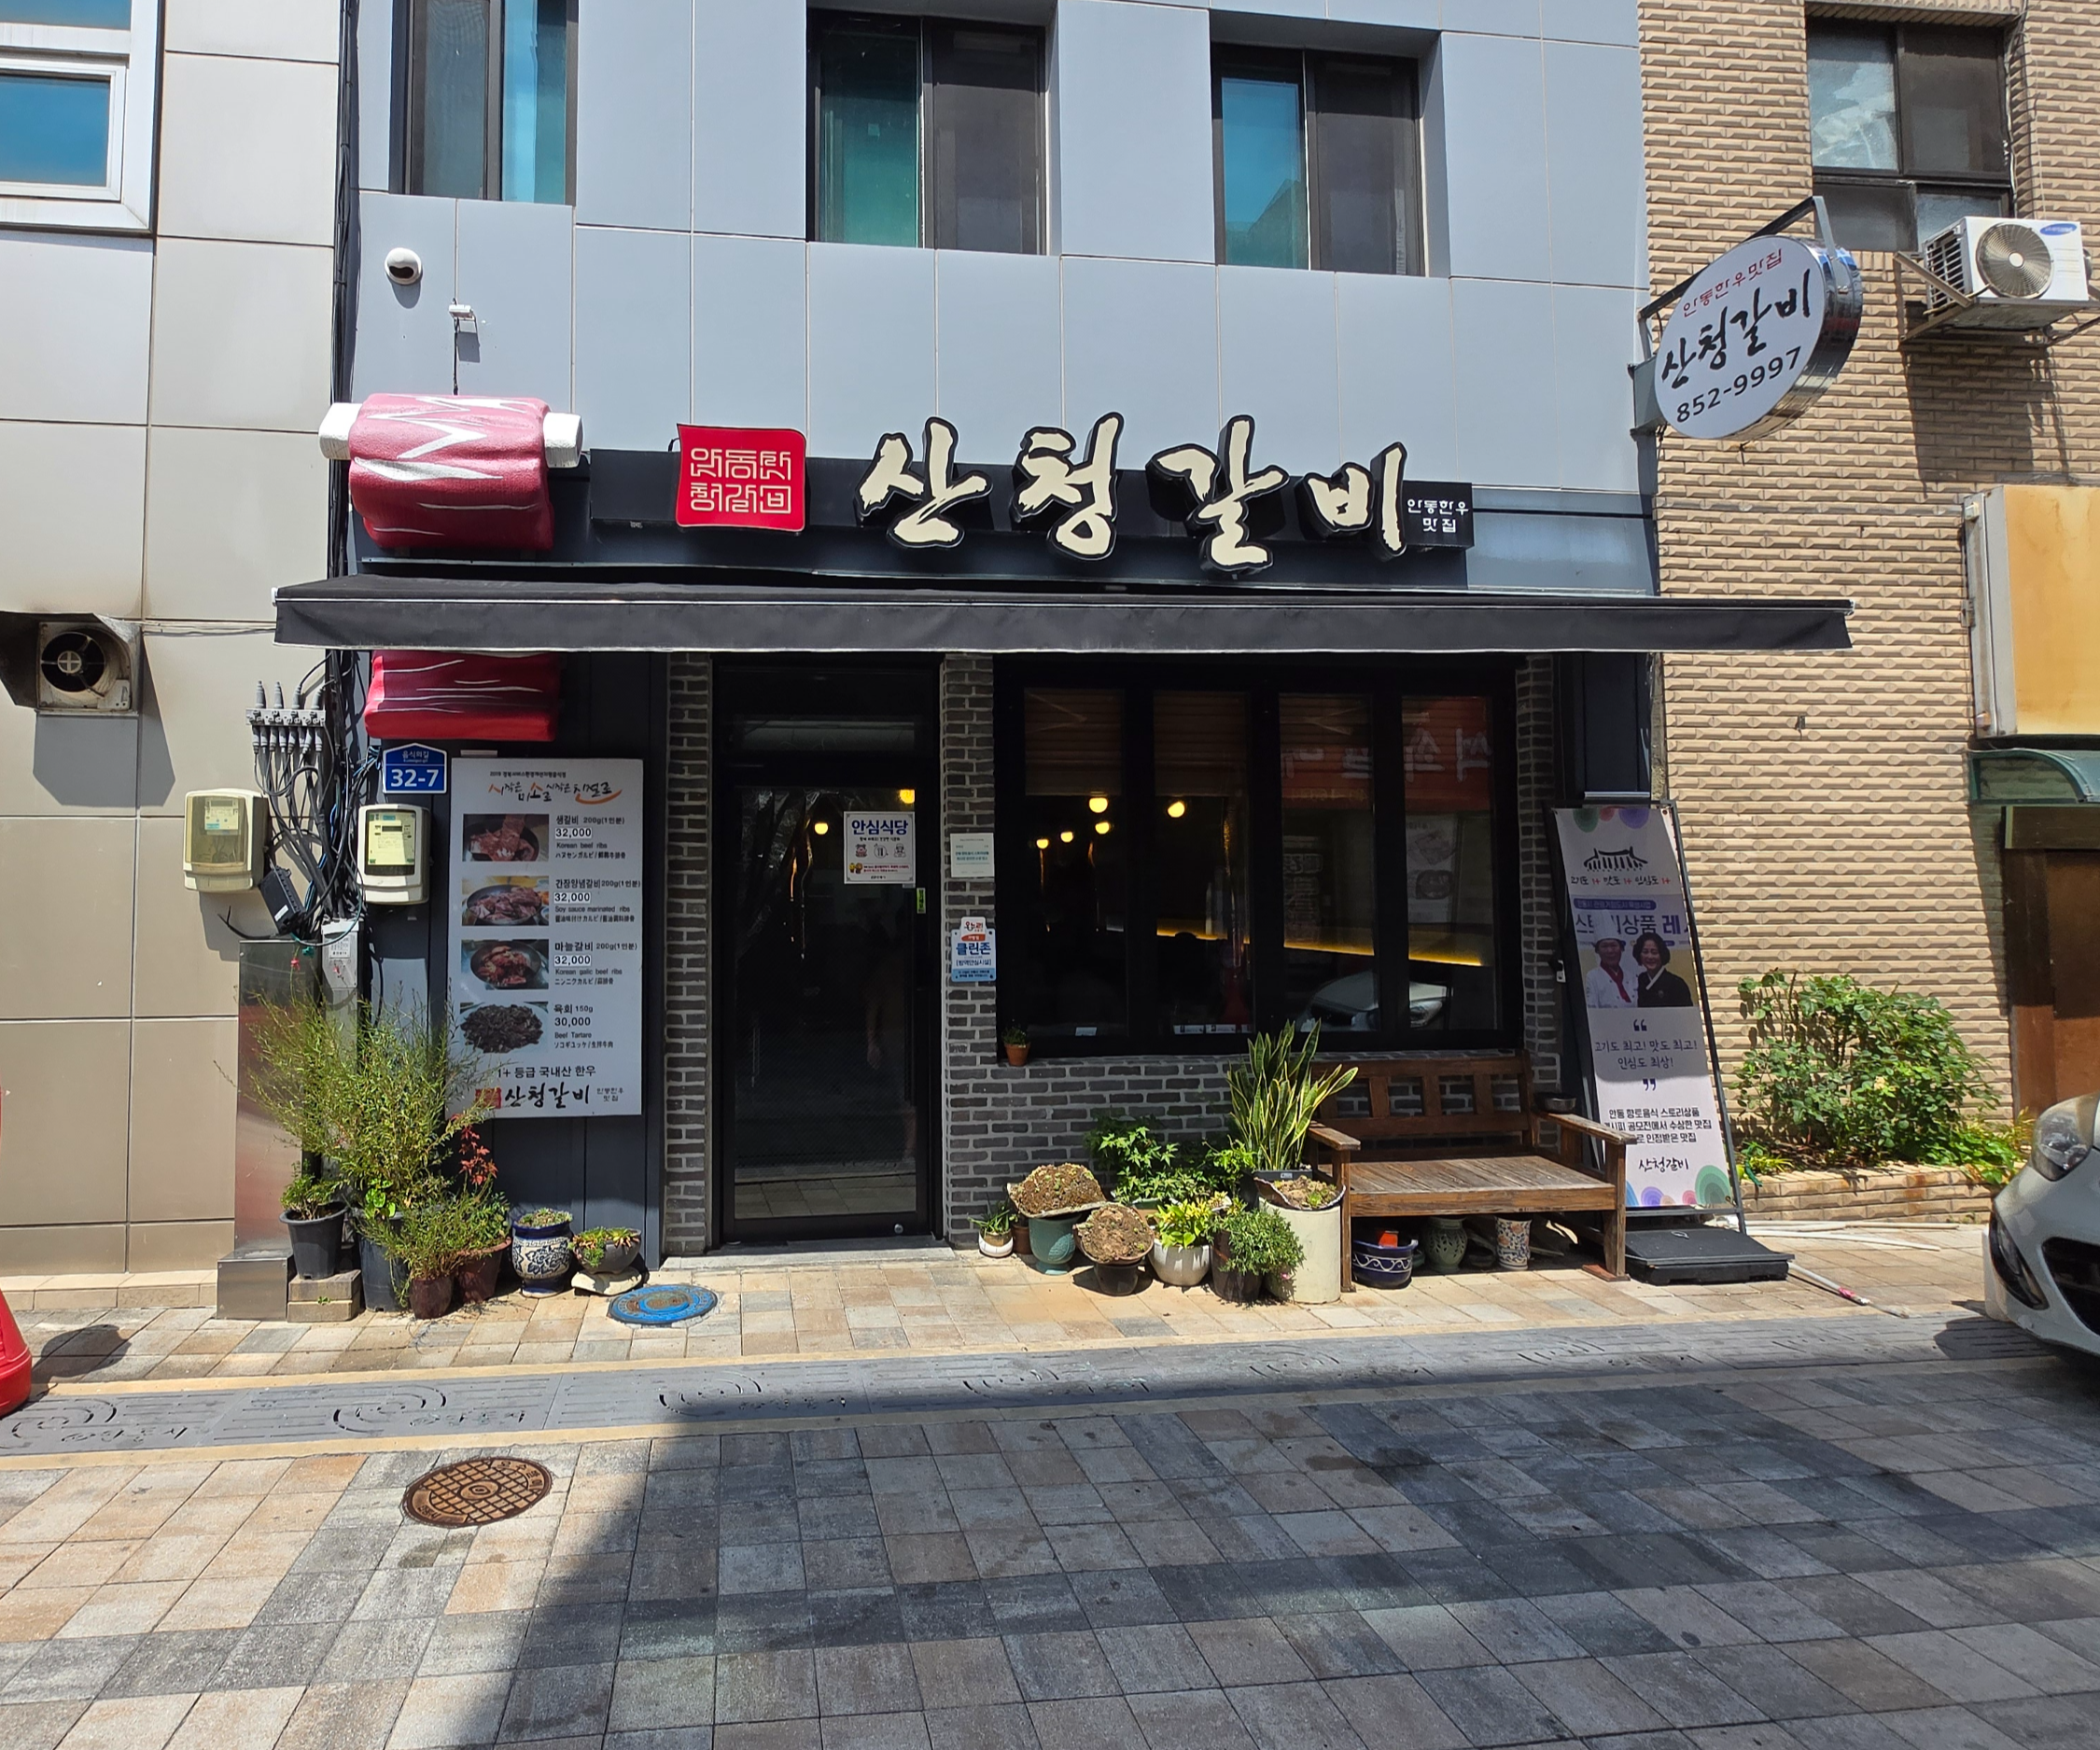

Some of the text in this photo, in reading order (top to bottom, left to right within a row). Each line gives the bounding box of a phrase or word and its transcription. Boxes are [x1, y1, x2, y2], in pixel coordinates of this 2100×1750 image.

[1661, 268, 1811, 389] 산청갈비
[1676, 346, 1801, 423] 852-9997
[859, 413, 1405, 571] 산청갈비
[1407, 498, 1469, 516] 안동한우
[1422, 517, 1457, 533] 맛집
[390, 768, 440, 788] 32-7
[556, 815, 579, 826] 생갈비
[851, 819, 909, 835] 안심식당
[555, 828, 592, 839] 32,000
[555, 878, 601, 889] 간장양념갈비
[1603, 875, 1621, 886] 맛도
[1634, 875, 1659, 886] 인심도
[554, 892, 590, 903] 32,000
[554, 942, 594, 952] 마늘갈비
[956, 942, 992, 956] 클린존
[554, 955, 591, 966] 32,000
[553, 1003, 594, 1015] 육회 150g
[554, 1016, 591, 1028] 30,000
[1594, 1040, 1698, 1053] 고기도 최고! 맛도 최고!
[1617, 1056, 1674, 1071] 인심도 최상!
[497, 1065, 596, 1079] 1+ 등급 국내산 한우
[505, 1081, 591, 1110] 산청갈비
[1609, 1107, 1701, 1120] 안동 향토음식 스토리상품
[1628, 1121, 1668, 1131] 공모전에서
[1669, 1120, 1693, 1130] 수상한
[1694, 1119, 1712, 1130] 맛집
[1646, 1133, 1679, 1144] 인정받은
[1679, 1132, 1697, 1143] 맛집
[1638, 1156, 1689, 1173] 산청갈비
